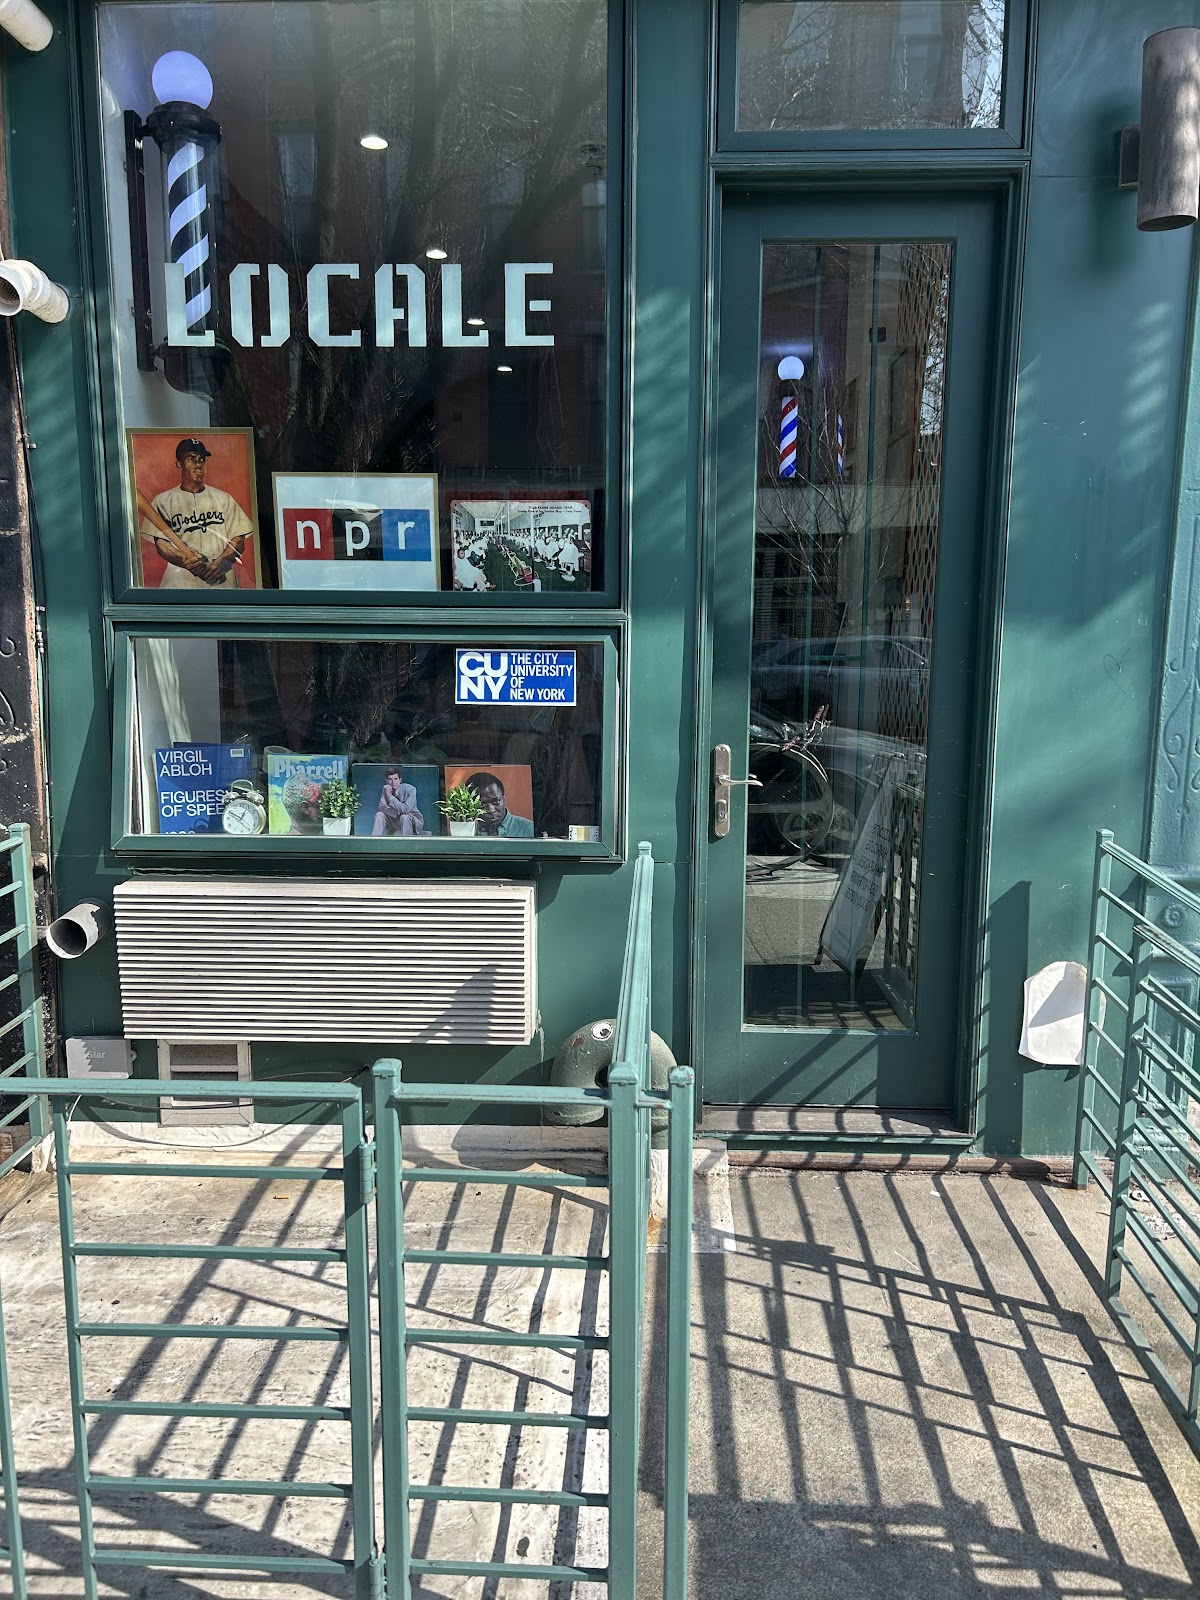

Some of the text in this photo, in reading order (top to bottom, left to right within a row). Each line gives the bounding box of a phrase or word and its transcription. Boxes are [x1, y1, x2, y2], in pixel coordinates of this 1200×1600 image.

[164, 262, 555, 348] LOCALE
[171, 511, 225, 533] Dodgers
[296, 519, 415, 557] npr
[511, 653, 559, 665] THE CITY
[511, 664, 573, 677] UNIVERSITY
[510, 677, 525, 688] OF
[510, 689, 565, 700] NEW YORK
[159, 750, 208, 763] VIRGIL
[159, 763, 212, 777] ABLOH
[274, 758, 344, 780] Pharrell
[161, 803, 225, 817] OF SPEE
[87, 1050, 106, 1059] Star
